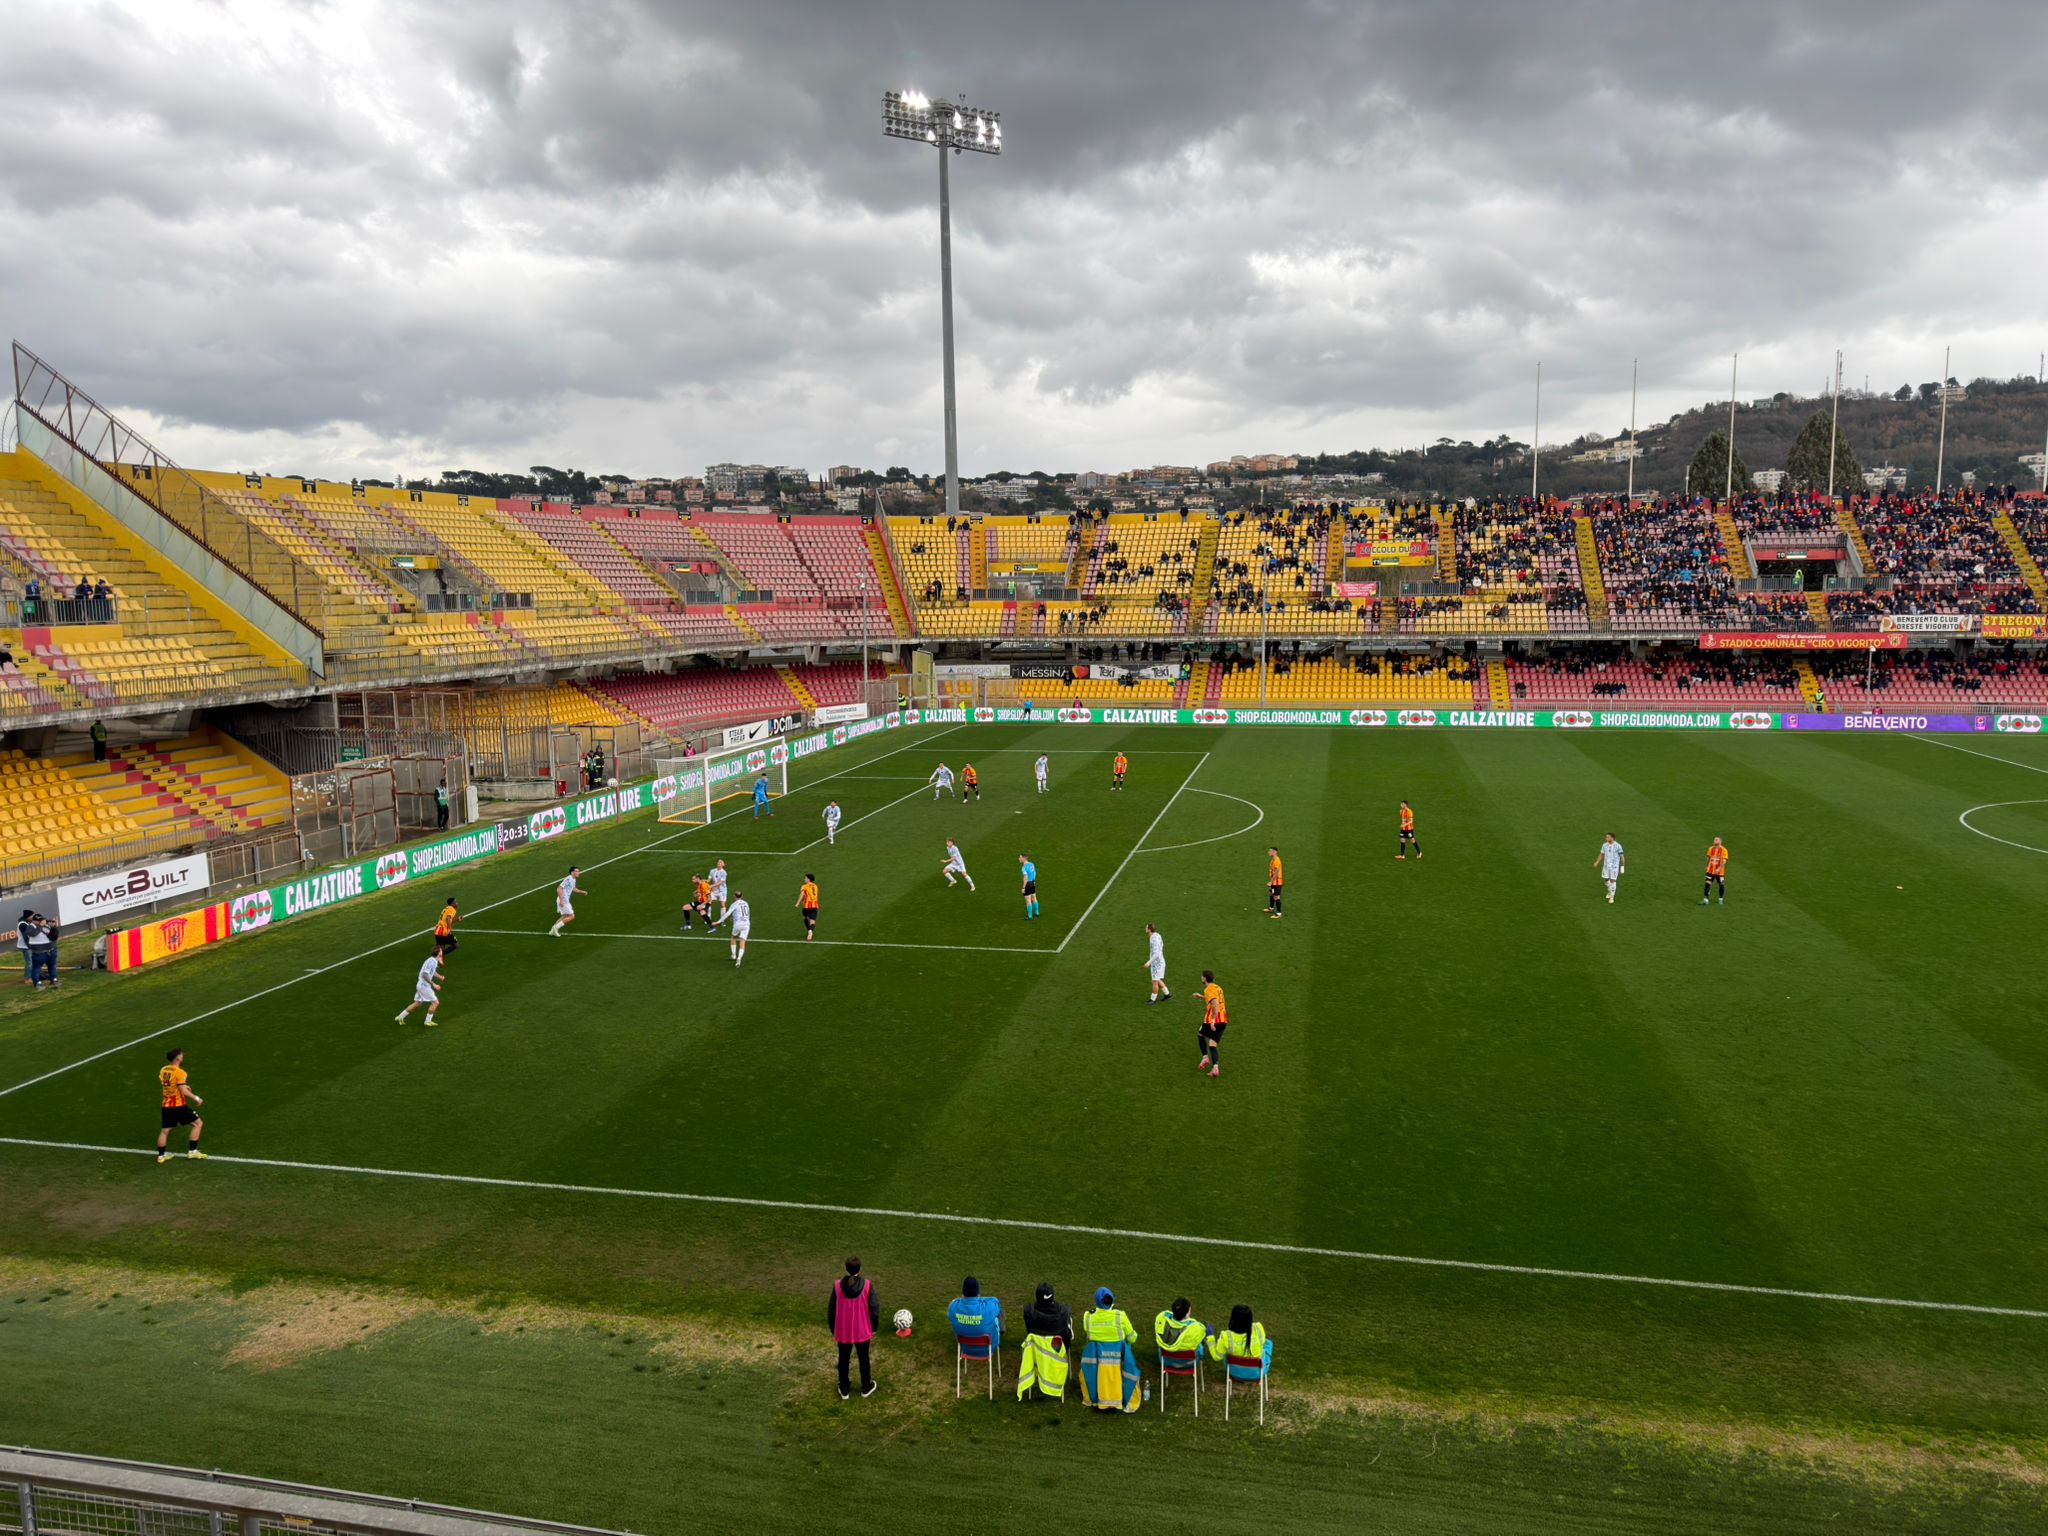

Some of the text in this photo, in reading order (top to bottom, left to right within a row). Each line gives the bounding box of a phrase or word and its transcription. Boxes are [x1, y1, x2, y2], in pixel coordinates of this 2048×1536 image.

[1983, 615, 2047, 626] STREGONI
[2000, 627, 2033, 638] NORD
[1719, 639, 1753, 648] STADIO
[1754, 639, 1806, 648] COMUNALE
[925, 709, 966, 722] CALZATURE
[1103, 709, 1178, 723] CALZATURE
[1234, 711, 1341, 724] SHOP.GLOBOMODA.COM
[1350, 710, 1387, 725] globo
[1399, 710, 1436, 725] globo
[1450, 711, 1535, 726] CALZATURE
[1553, 711, 1593, 727] globo
[1600, 713, 1720, 727] SHOP.GLOBOMODA.COM
[1730, 713, 1771, 729] globo
[1844, 716, 1928, 729] BENEVENTO
[1998, 715, 2042, 732] globo
[793, 733, 828, 758] CALZATURE
[680, 759, 743, 792] SHOP.GLBOMODA.COM
[577, 787, 641, 824] CALZATURE
[531, 807, 566, 839] globo
[503, 824, 528, 841] 20:33
[412, 829, 495, 874] SHOP.GLOBOMODA.COM
[285, 866, 363, 915] CALZATURE
